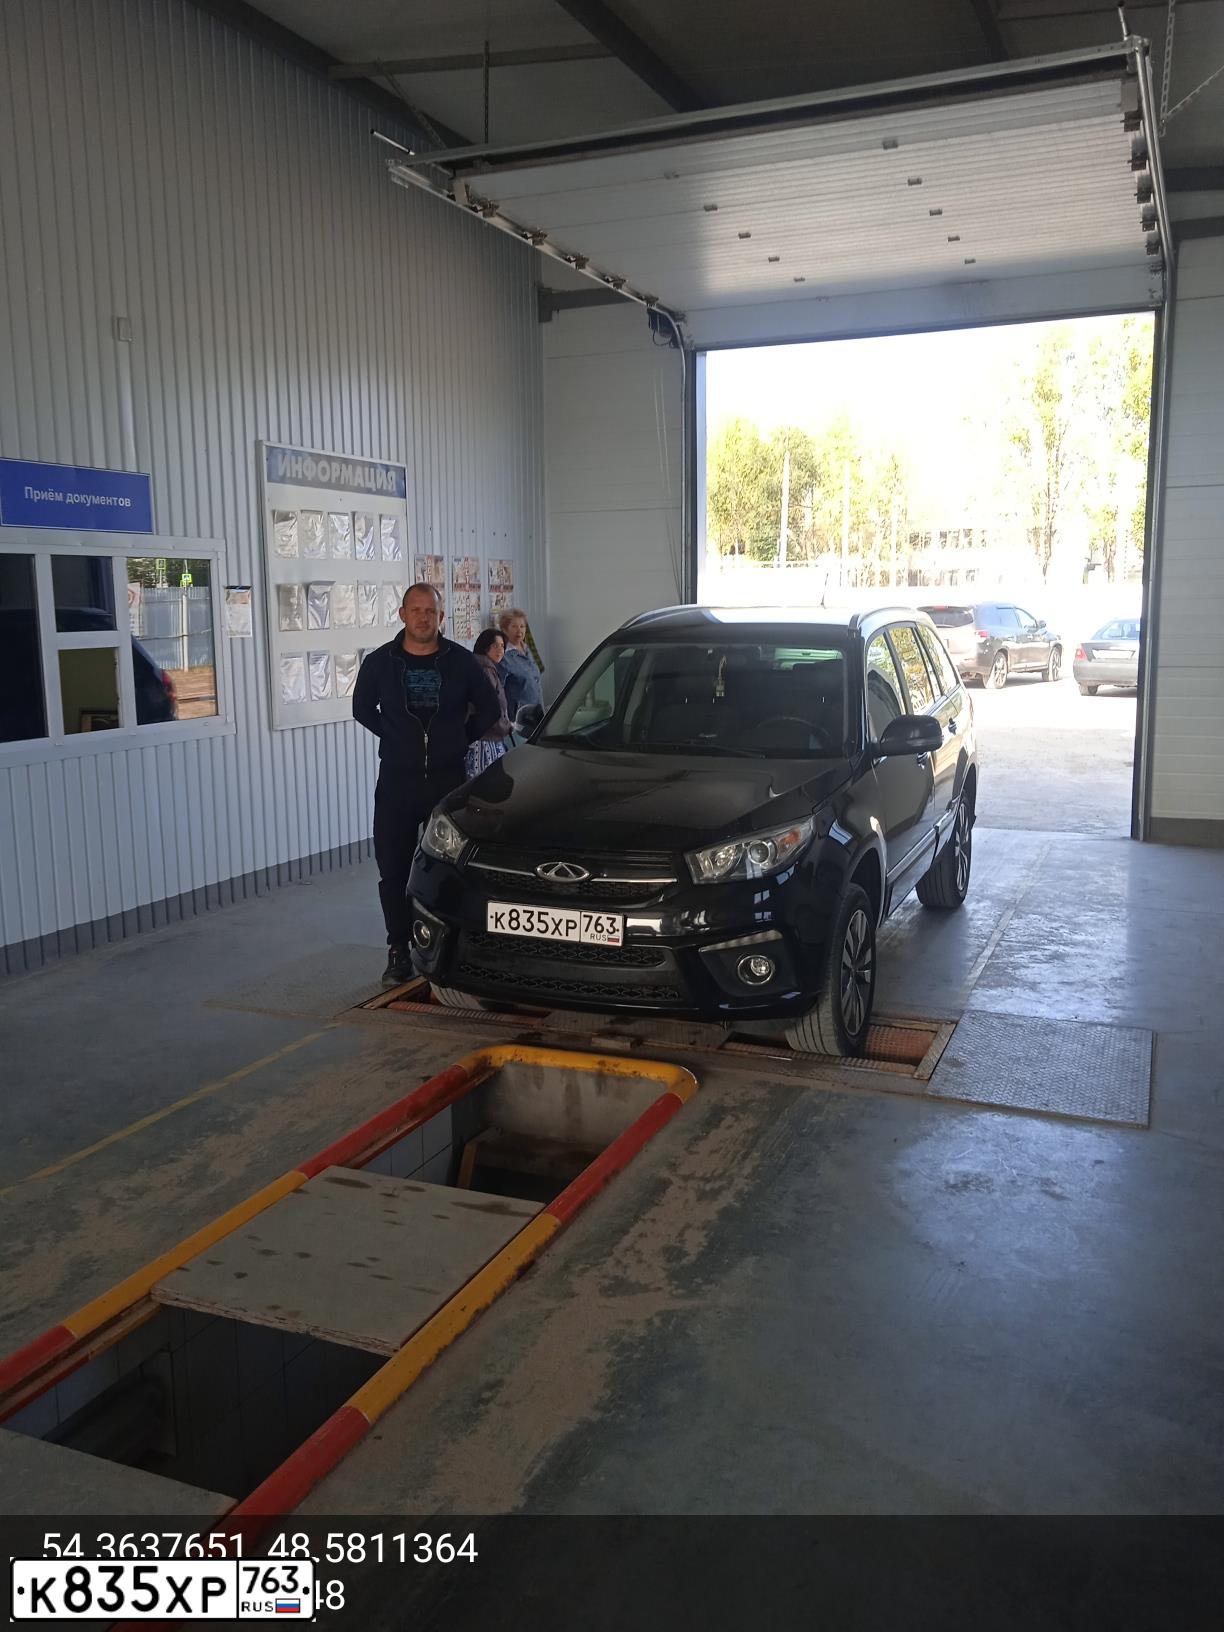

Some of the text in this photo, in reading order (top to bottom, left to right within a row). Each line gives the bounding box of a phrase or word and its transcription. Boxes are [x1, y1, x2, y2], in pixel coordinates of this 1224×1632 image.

[277, 453, 396, 494] ИНФОРМАЦИЯ
[24, 486, 132, 508] Приём документов
[494, 908, 618, 937] К835ХР 763
[589, 933, 607, 942] RUS
